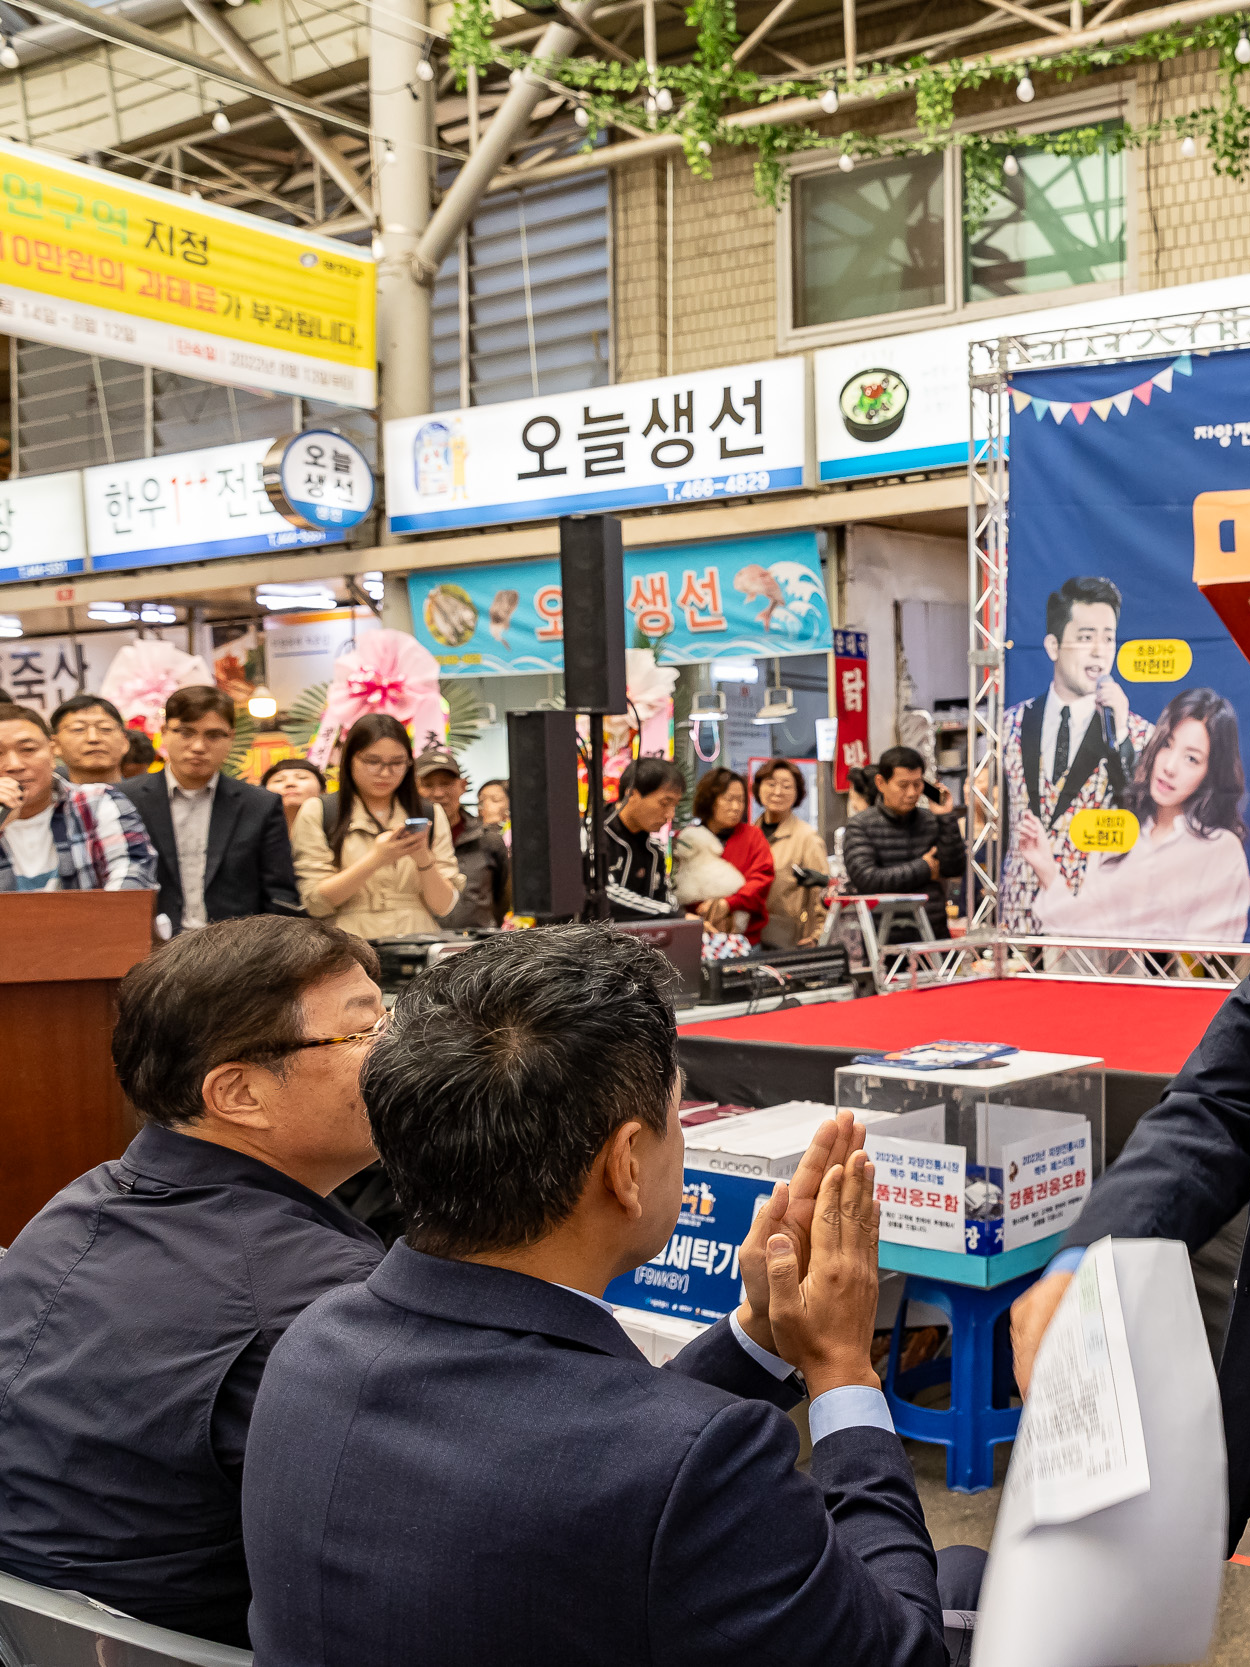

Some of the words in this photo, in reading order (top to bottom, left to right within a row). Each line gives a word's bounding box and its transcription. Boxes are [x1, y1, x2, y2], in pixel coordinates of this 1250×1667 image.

[144, 218, 209, 266] 지정
[517, 379, 765, 481] 오늘생선
[533, 566, 727, 642] 오생선
[709, 1159, 763, 1176] CUCKOO
[1010, 1169, 1086, 1210] 경품권응모함
